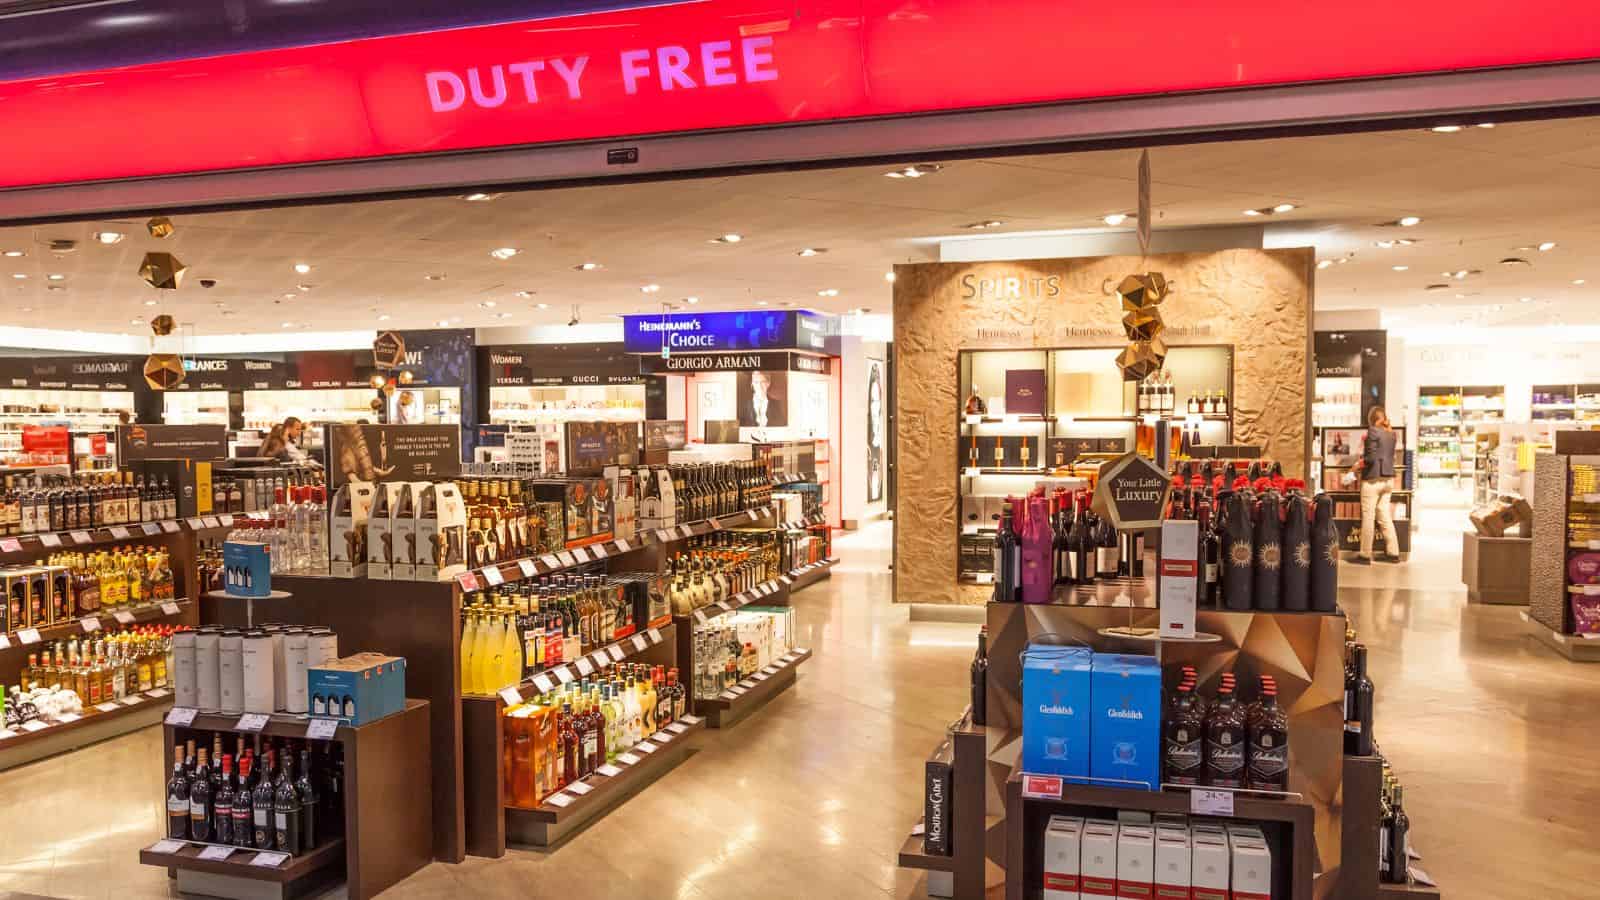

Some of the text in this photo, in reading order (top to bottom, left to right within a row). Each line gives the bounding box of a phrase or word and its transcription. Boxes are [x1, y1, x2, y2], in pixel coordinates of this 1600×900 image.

[424, 36, 778, 113] DUTY FREE
[961, 273, 1060, 300] SPIRITS
[670, 332, 716, 347] CHOICE
[491, 354, 523, 365] WOMEN
[667, 356, 761, 370] GIORGIO ARMANI
[572, 375, 599, 384] GUCCI
[1118, 478, 1161, 488] Your Little
[1116, 488, 1162, 504] Luxury
